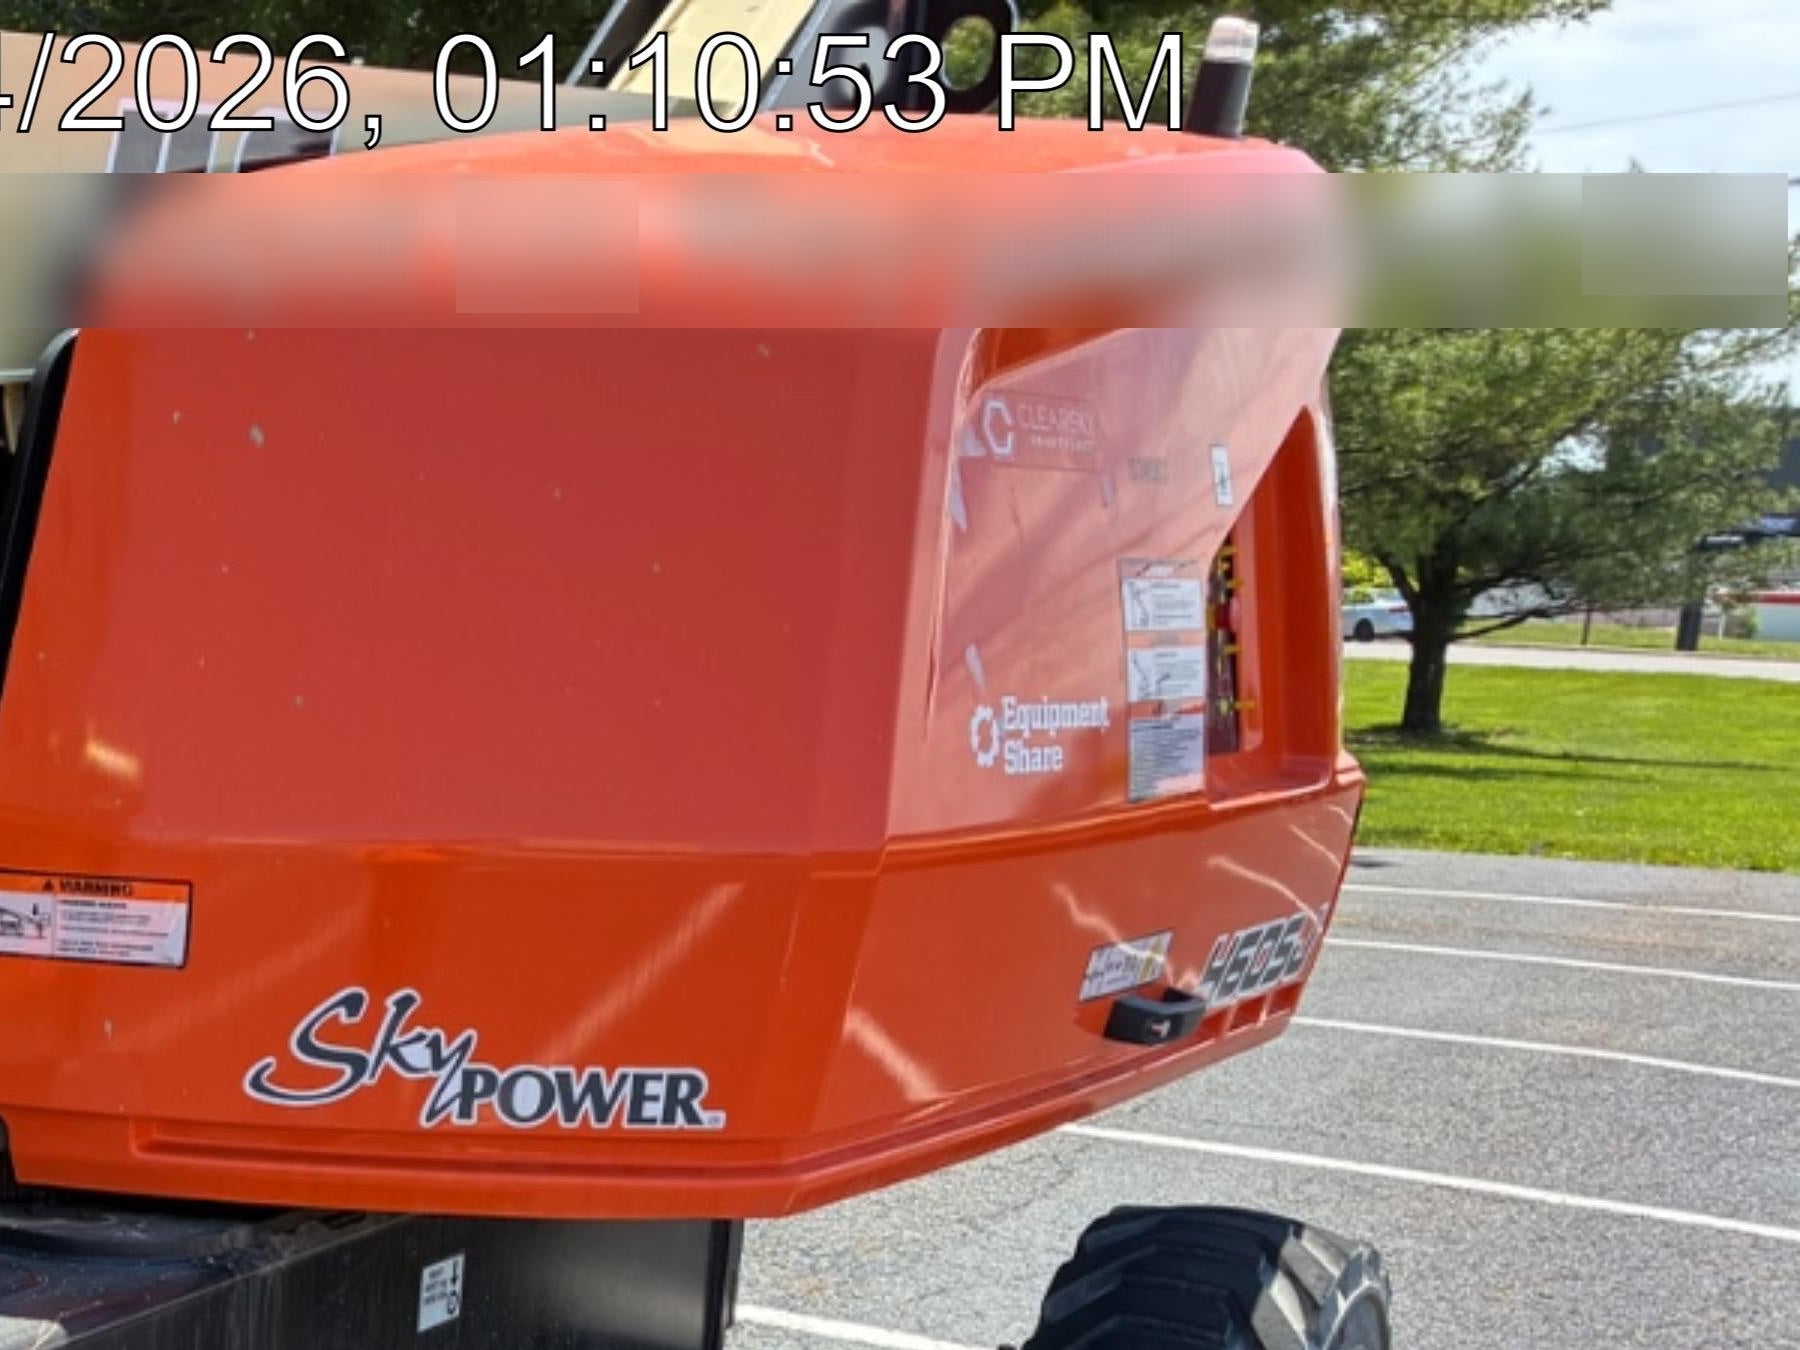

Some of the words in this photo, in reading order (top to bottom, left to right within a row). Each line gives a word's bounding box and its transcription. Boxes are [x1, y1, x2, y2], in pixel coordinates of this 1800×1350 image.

[1001, 695, 1110, 738] Equipment
[1004, 739, 1063, 774] Share
[245, 987, 477, 1128] Sky
[454, 1064, 710, 1128] POWER
